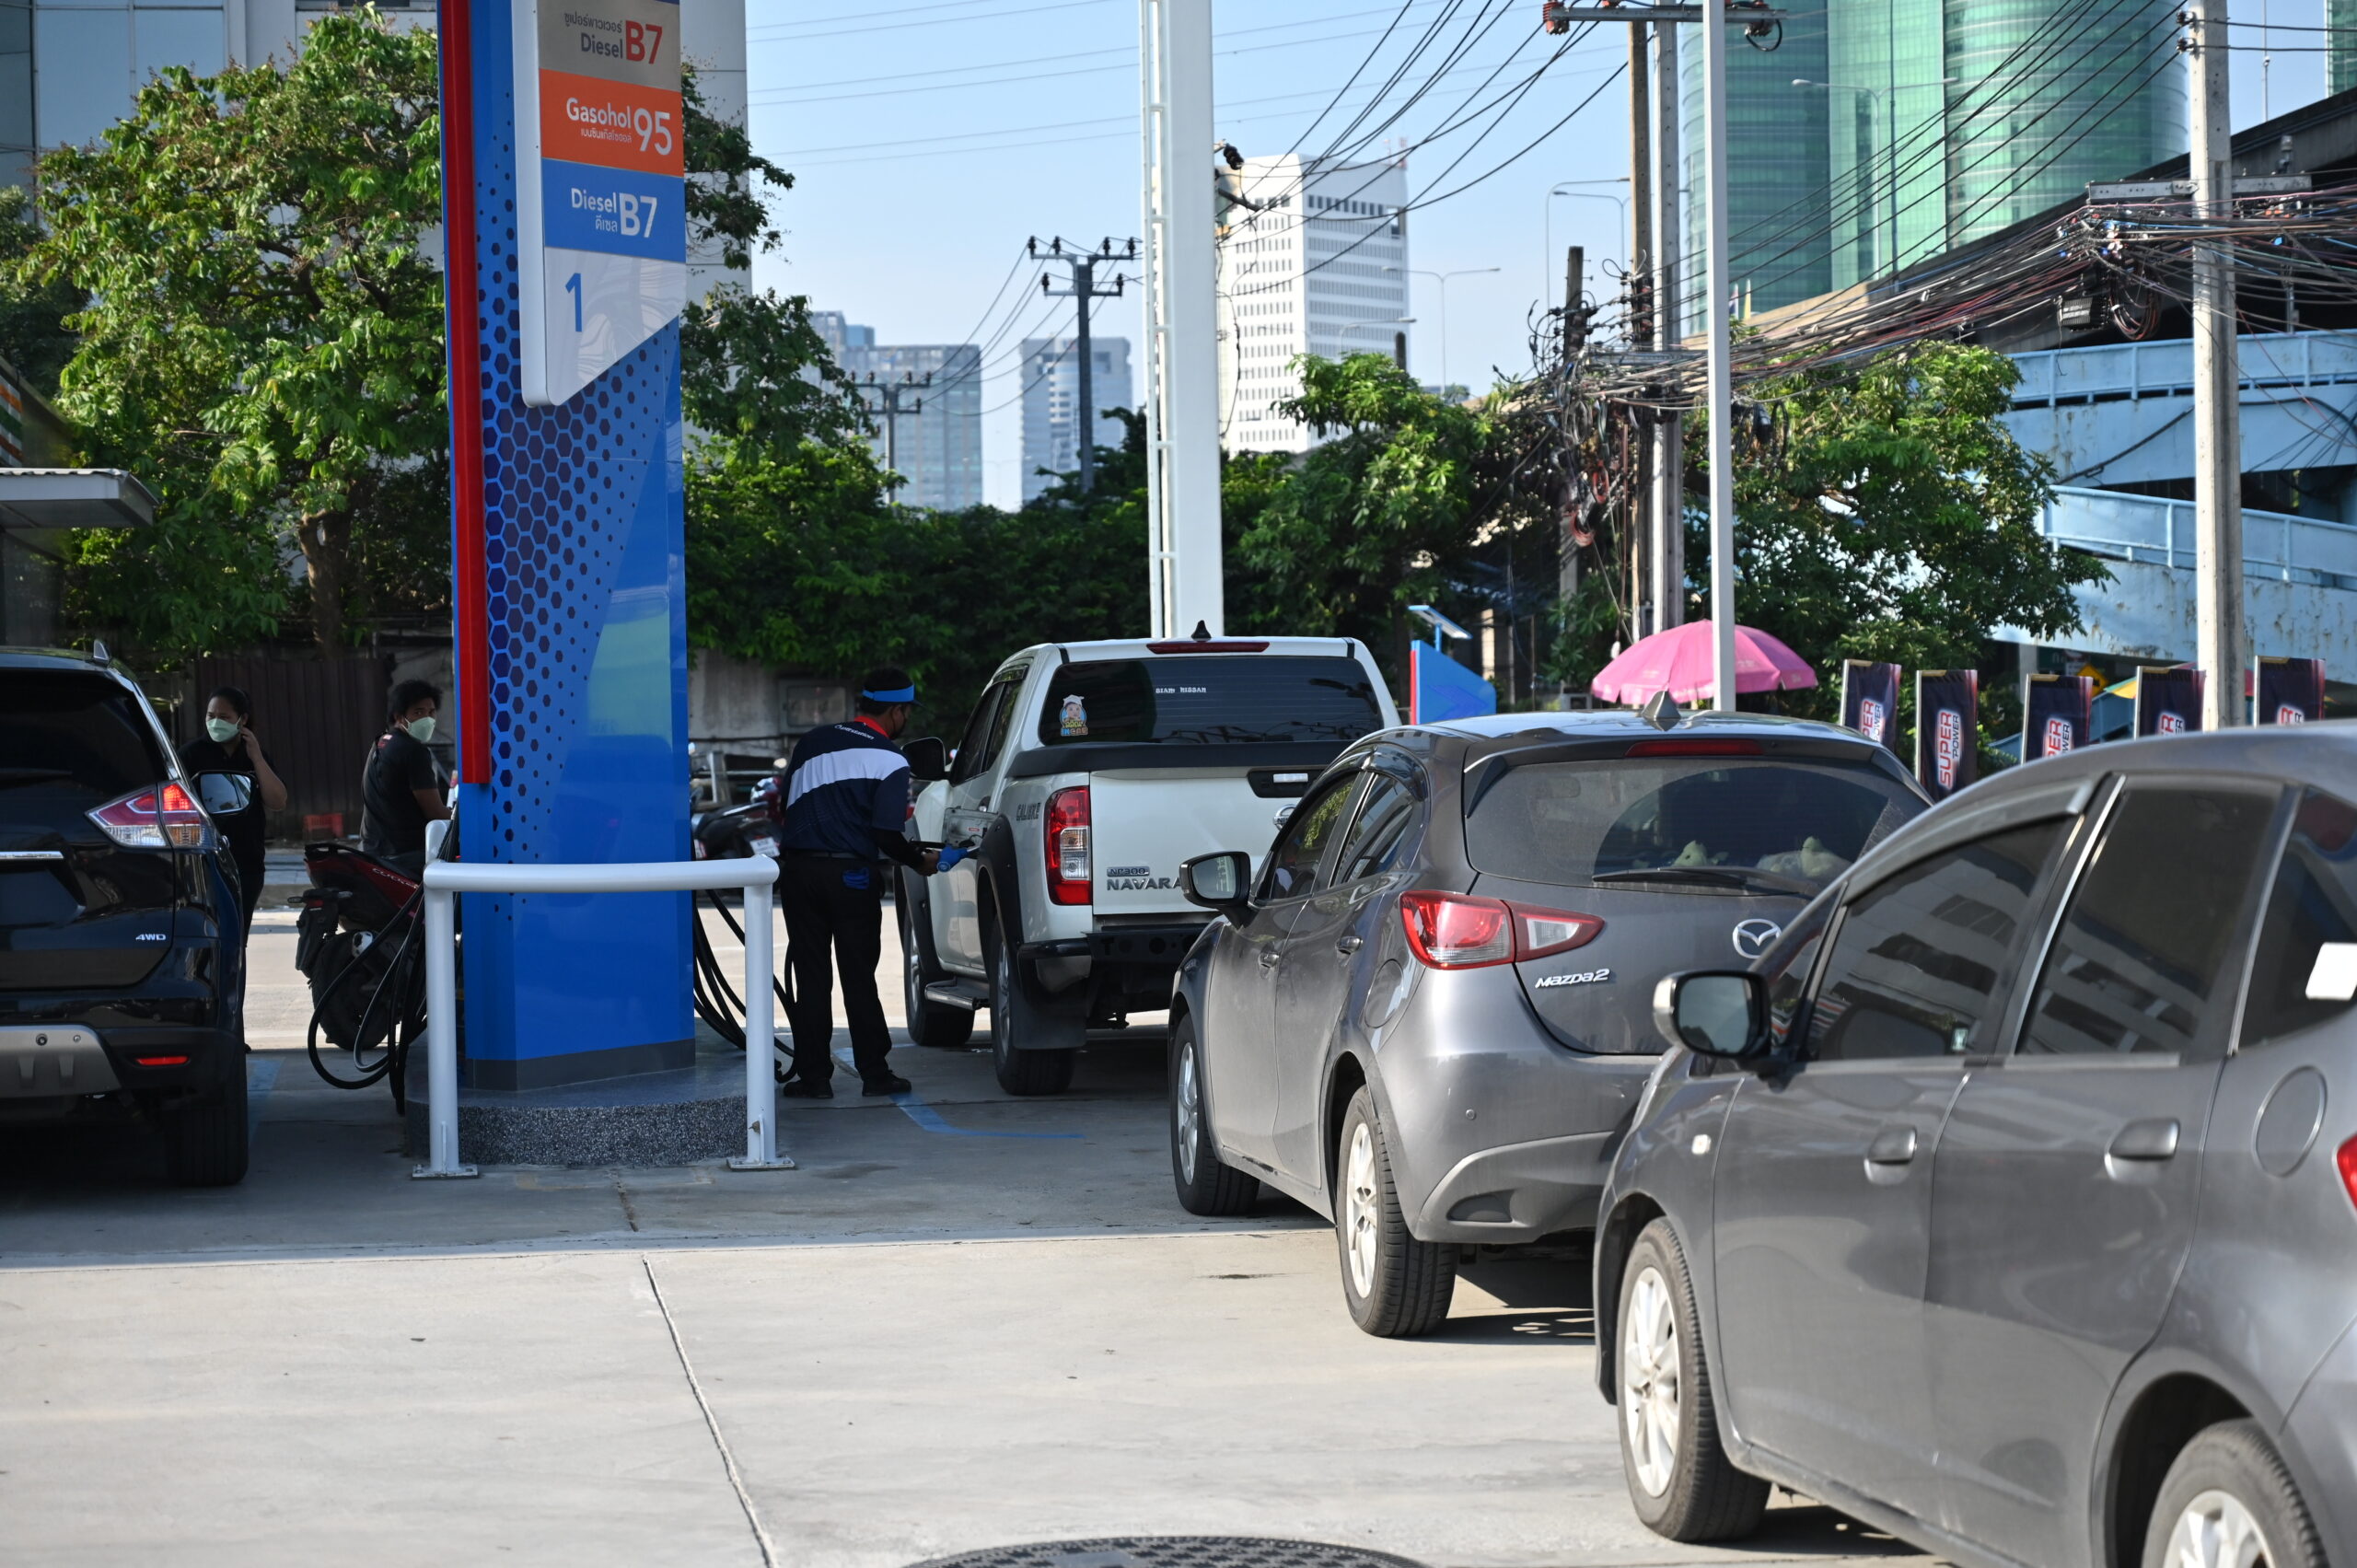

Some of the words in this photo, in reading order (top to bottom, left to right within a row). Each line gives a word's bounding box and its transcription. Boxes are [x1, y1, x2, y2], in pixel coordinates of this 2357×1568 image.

[580, 32, 623, 59] Diesel
[625, 19, 663, 64] B7
[566, 97, 632, 129] Gasohol
[633, 107, 673, 156] 95
[571, 187, 617, 214] Diesel
[619, 192, 657, 238] B7
[595, 215, 618, 232] ดีเซล
[564, 273, 583, 332] 1
[1862, 700, 1875, 738] PER
[1952, 714, 1961, 760] POWER
[2061, 724, 2071, 752] WER
[1939, 711, 1952, 789] SUPER
[1107, 877, 1182, 891] NAVARA
